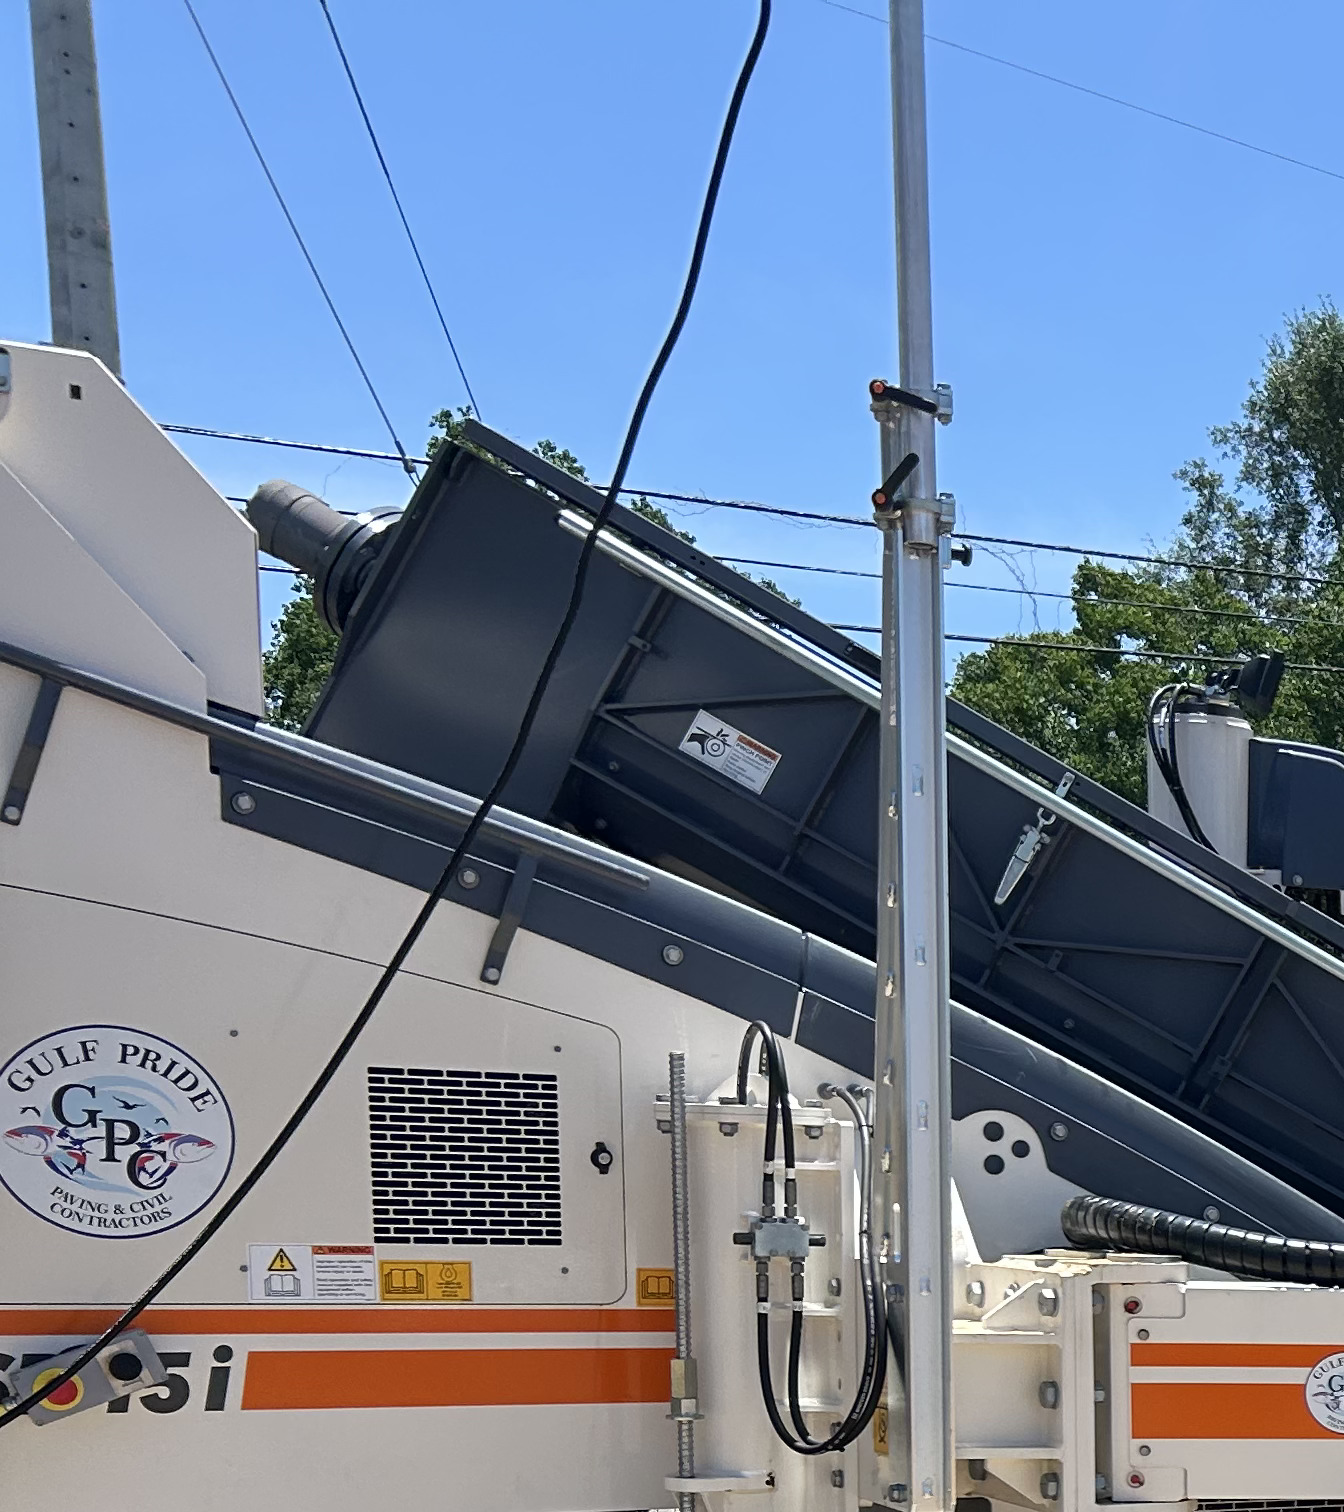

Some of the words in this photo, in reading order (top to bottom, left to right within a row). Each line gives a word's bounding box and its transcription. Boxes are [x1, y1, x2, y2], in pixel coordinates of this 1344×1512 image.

[6, 1039, 99, 1092] GULF
[117, 1042, 218, 1113] PRIDE
[50, 1185, 109, 1215] PAVING
[113, 1203, 124, 1215] &
[129, 1192, 173, 1214] CIVIL
[49, 1202, 173, 1229] CONTRACTORS
[1312, 1357, 1344, 1380] GULF
